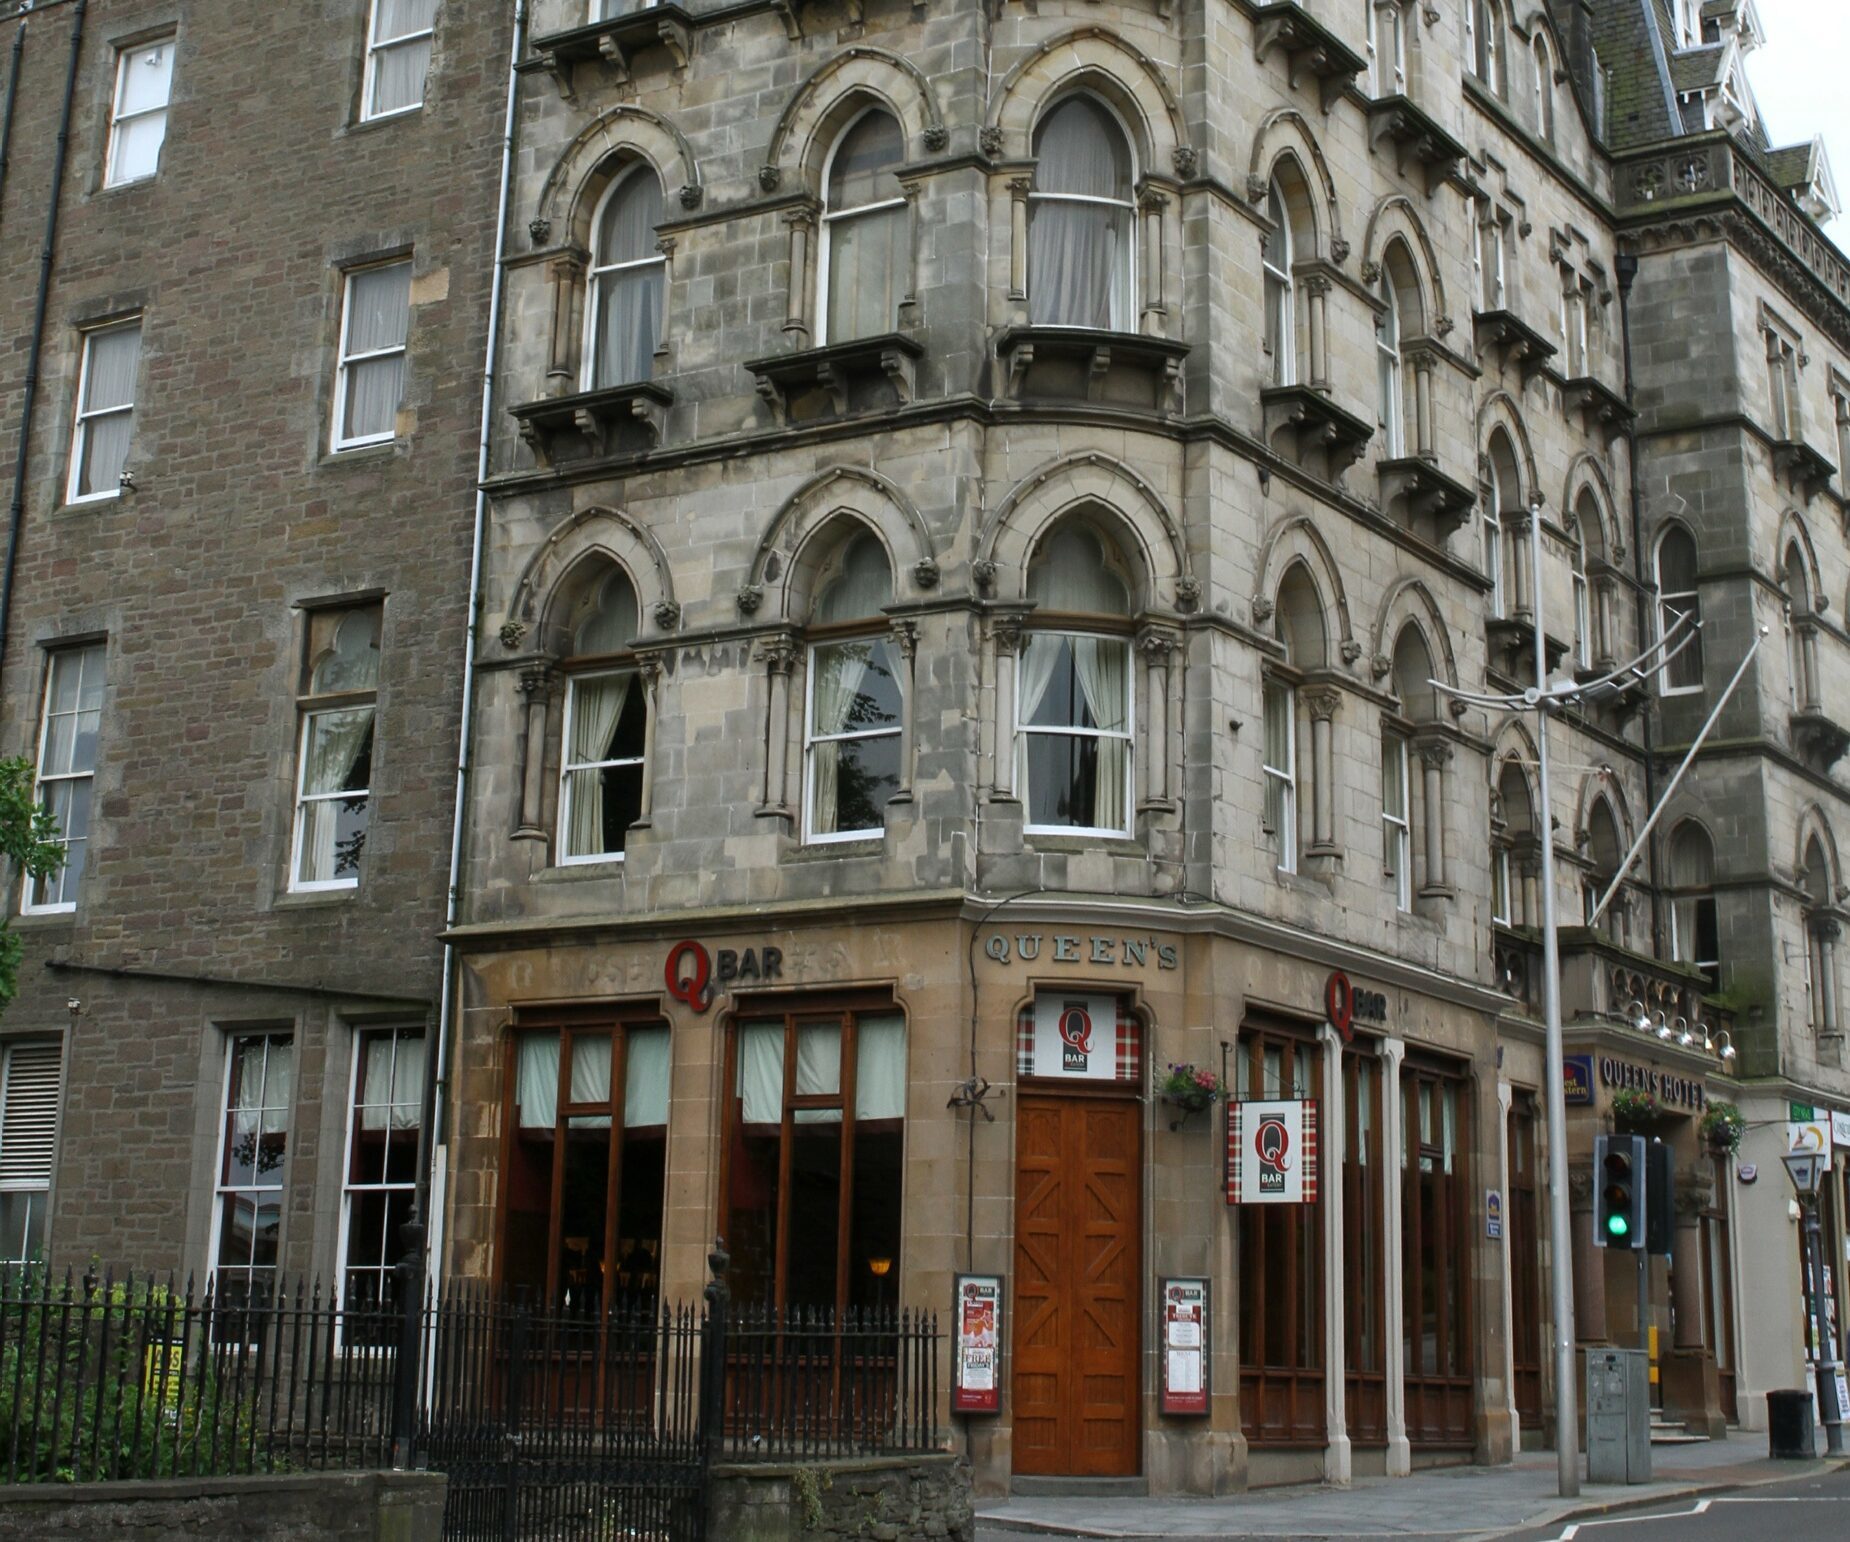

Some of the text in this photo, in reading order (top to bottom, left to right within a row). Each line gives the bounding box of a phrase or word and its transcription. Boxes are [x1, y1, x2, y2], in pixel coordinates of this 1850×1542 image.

[665, 940, 714, 1013] Q
[717, 947, 783, 980] BAR
[986, 935, 1177, 969] QUEEN'S
[1058, 1007, 1095, 1055] Q
[1324, 970, 1354, 1043] Q
[1352, 986, 1386, 1021] BAR
[1065, 1054, 1085, 1062] BAR
[1603, 1057, 1707, 1108] QUEENS HOTEL
[1254, 1119, 1293, 1174] Q
[1261, 1174, 1282, 1183] BAR
